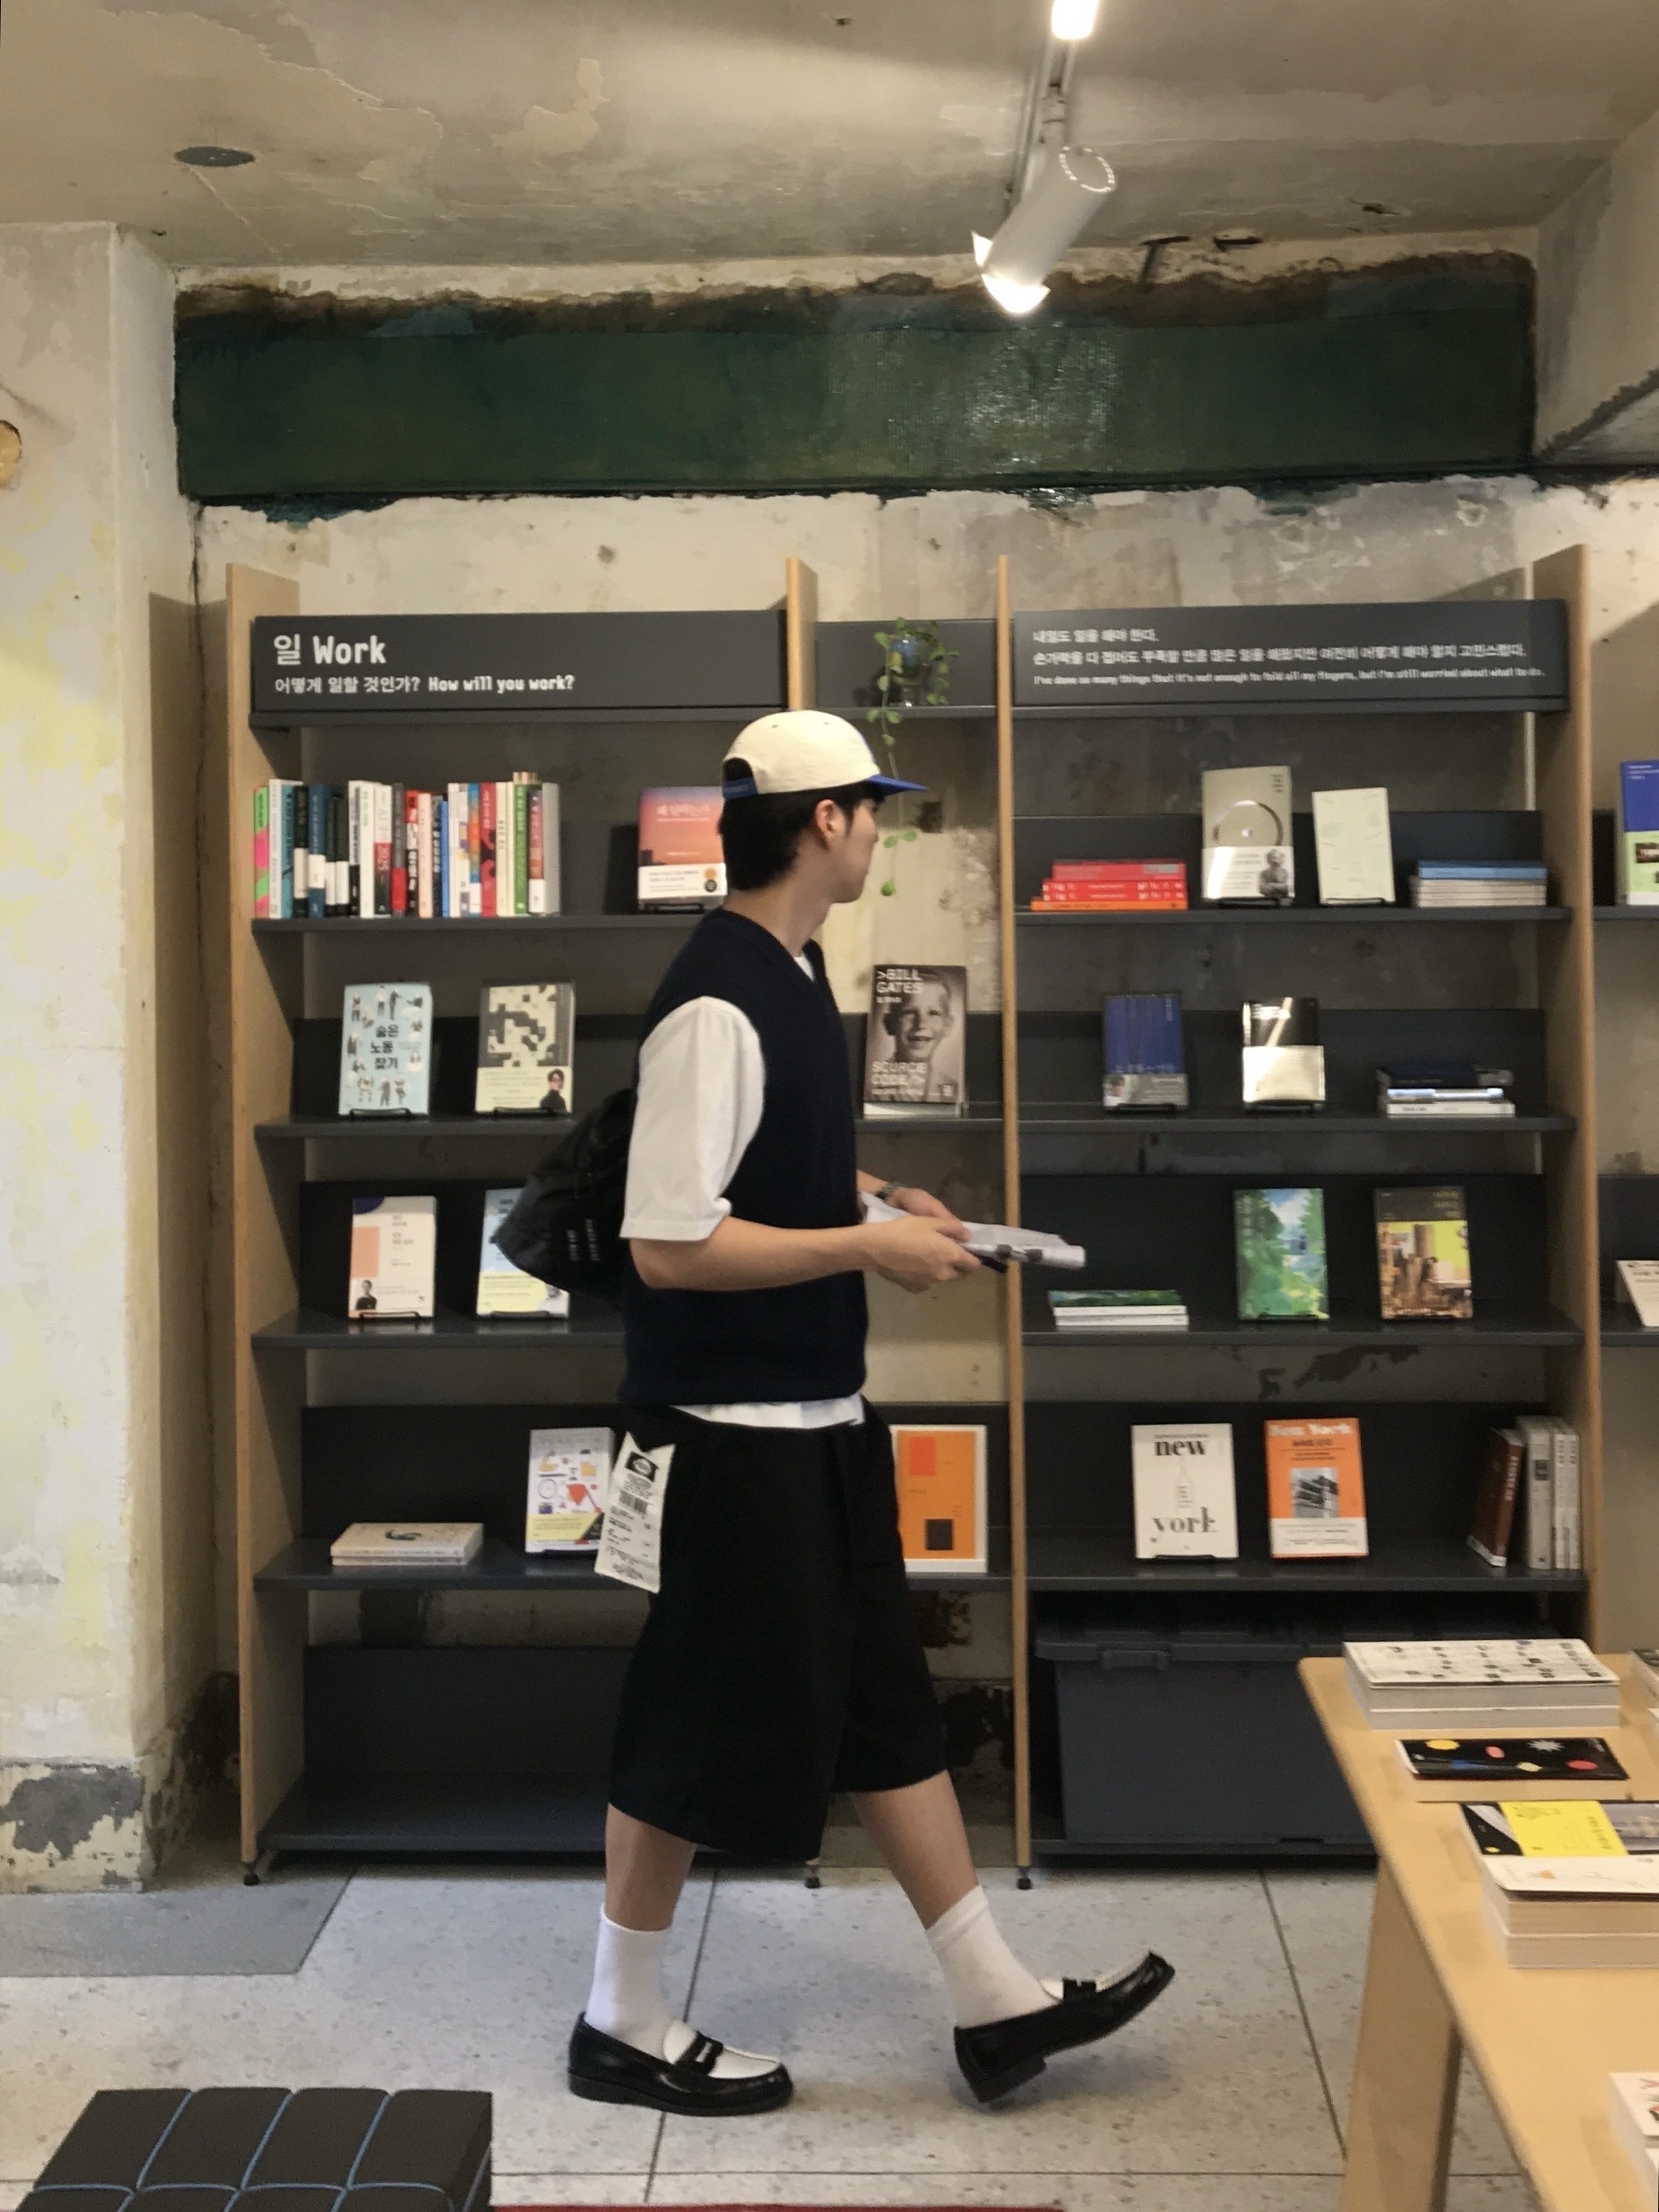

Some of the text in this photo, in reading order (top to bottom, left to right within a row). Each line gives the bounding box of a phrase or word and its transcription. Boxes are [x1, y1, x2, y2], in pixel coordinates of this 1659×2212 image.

[273, 634, 387, 665] 일 Work
[1085, 651, 1100, 664] 다
[275, 675, 574, 694] 어떻게 일할 것인가? How will you work?
[1154, 1440, 1207, 1457] new
